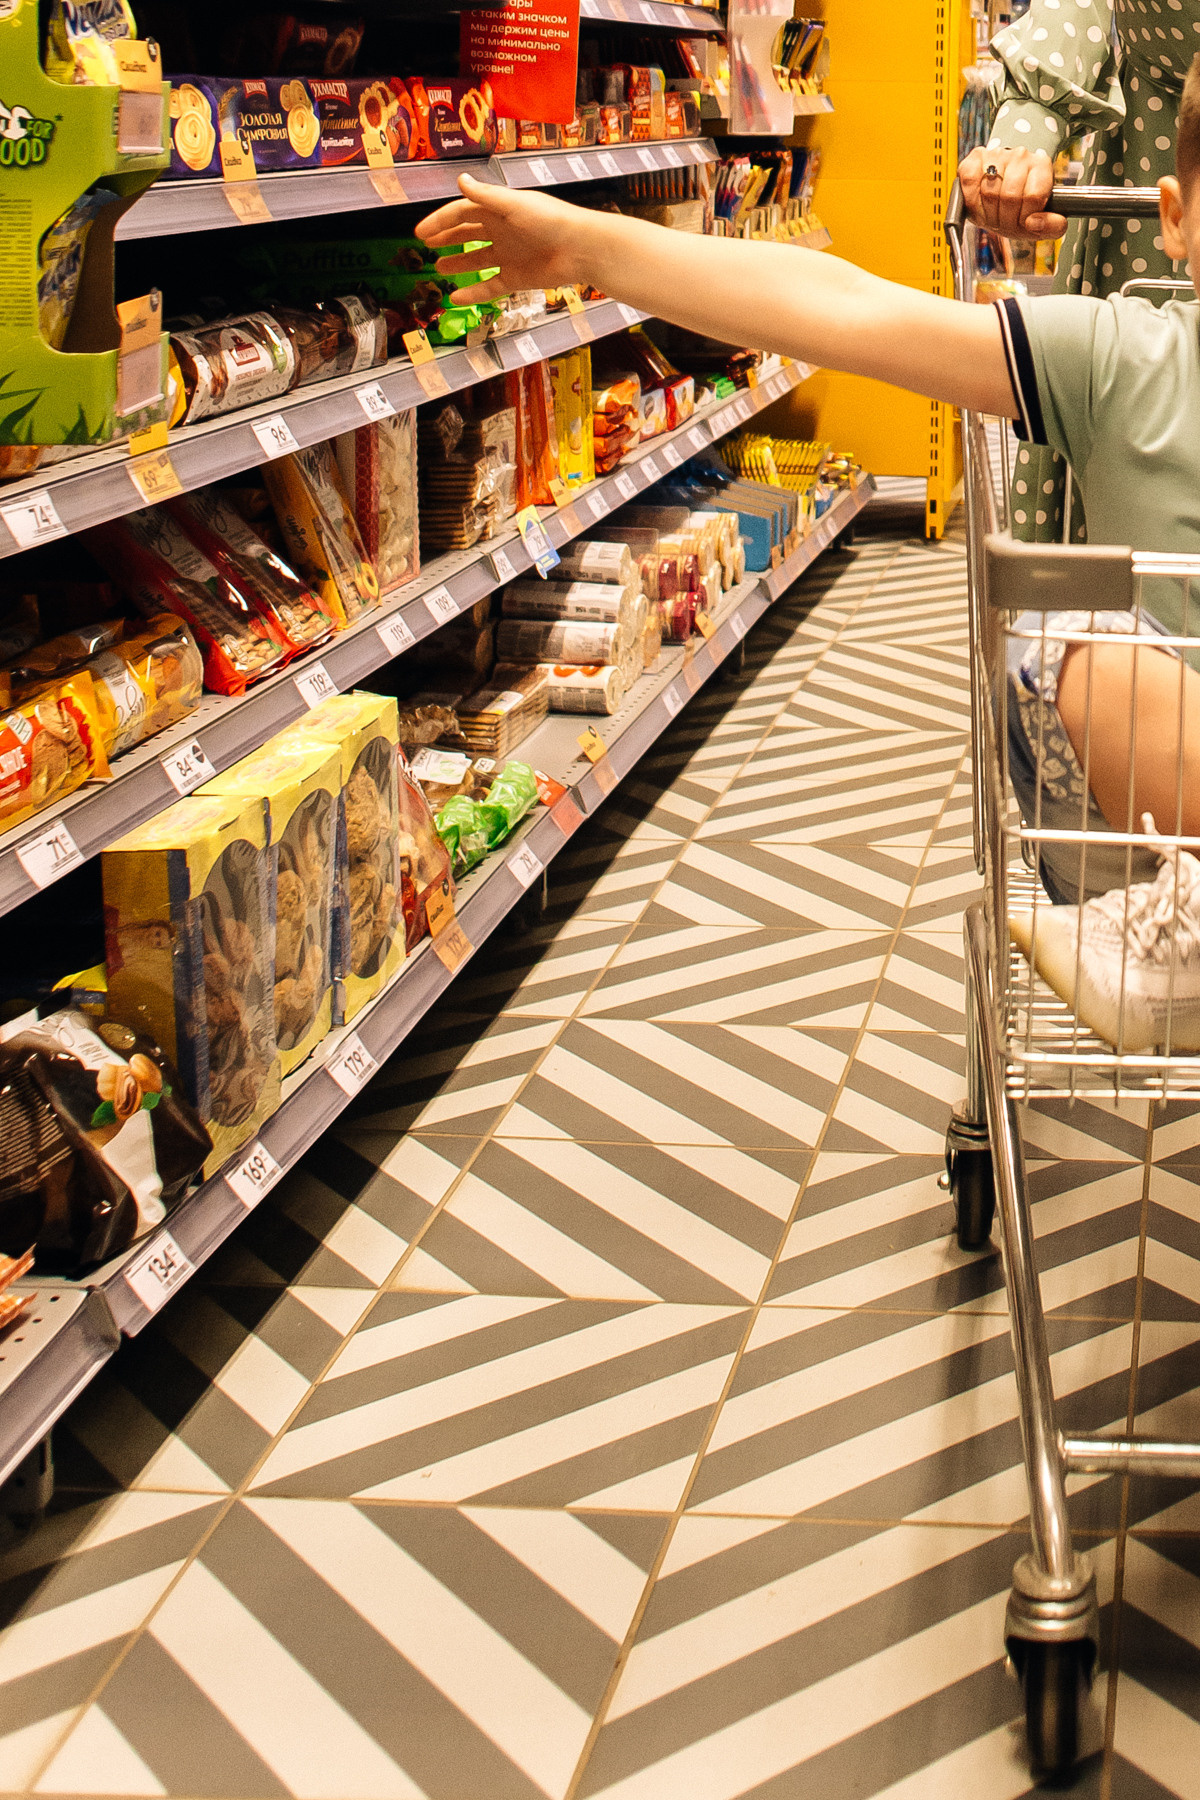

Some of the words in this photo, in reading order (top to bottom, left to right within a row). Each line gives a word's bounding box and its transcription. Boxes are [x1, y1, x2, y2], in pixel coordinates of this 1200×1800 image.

[481, 10, 516, 20] таким
[518, 12, 568, 24] значком
[470, 23, 488, 31] мы
[491, 24, 537, 36] держим
[540, 28, 570, 39] цены
[488, 38, 561, 51] минимально
[470, 50, 537, 63] возможном
[470, 64, 515, 75] уровне!
[238, 111, 283, 127] ЗОЛОТАЯ
[236, 127, 289, 142] СИМФОНИЯ
[270, 426, 287, 444] 96
[142, 469, 158, 489] 69
[28, 505, 53, 529] 74
[435, 597, 450, 612] 109
[390, 624, 406, 641] 119
[308, 673, 326, 694] 119
[175, 756, 194, 778] 84
[46, 837, 68, 862] 71
[342, 1053, 367, 1078] 179
[241, 1156, 268, 1187] 169
[147, 1248, 178, 1284] 134
